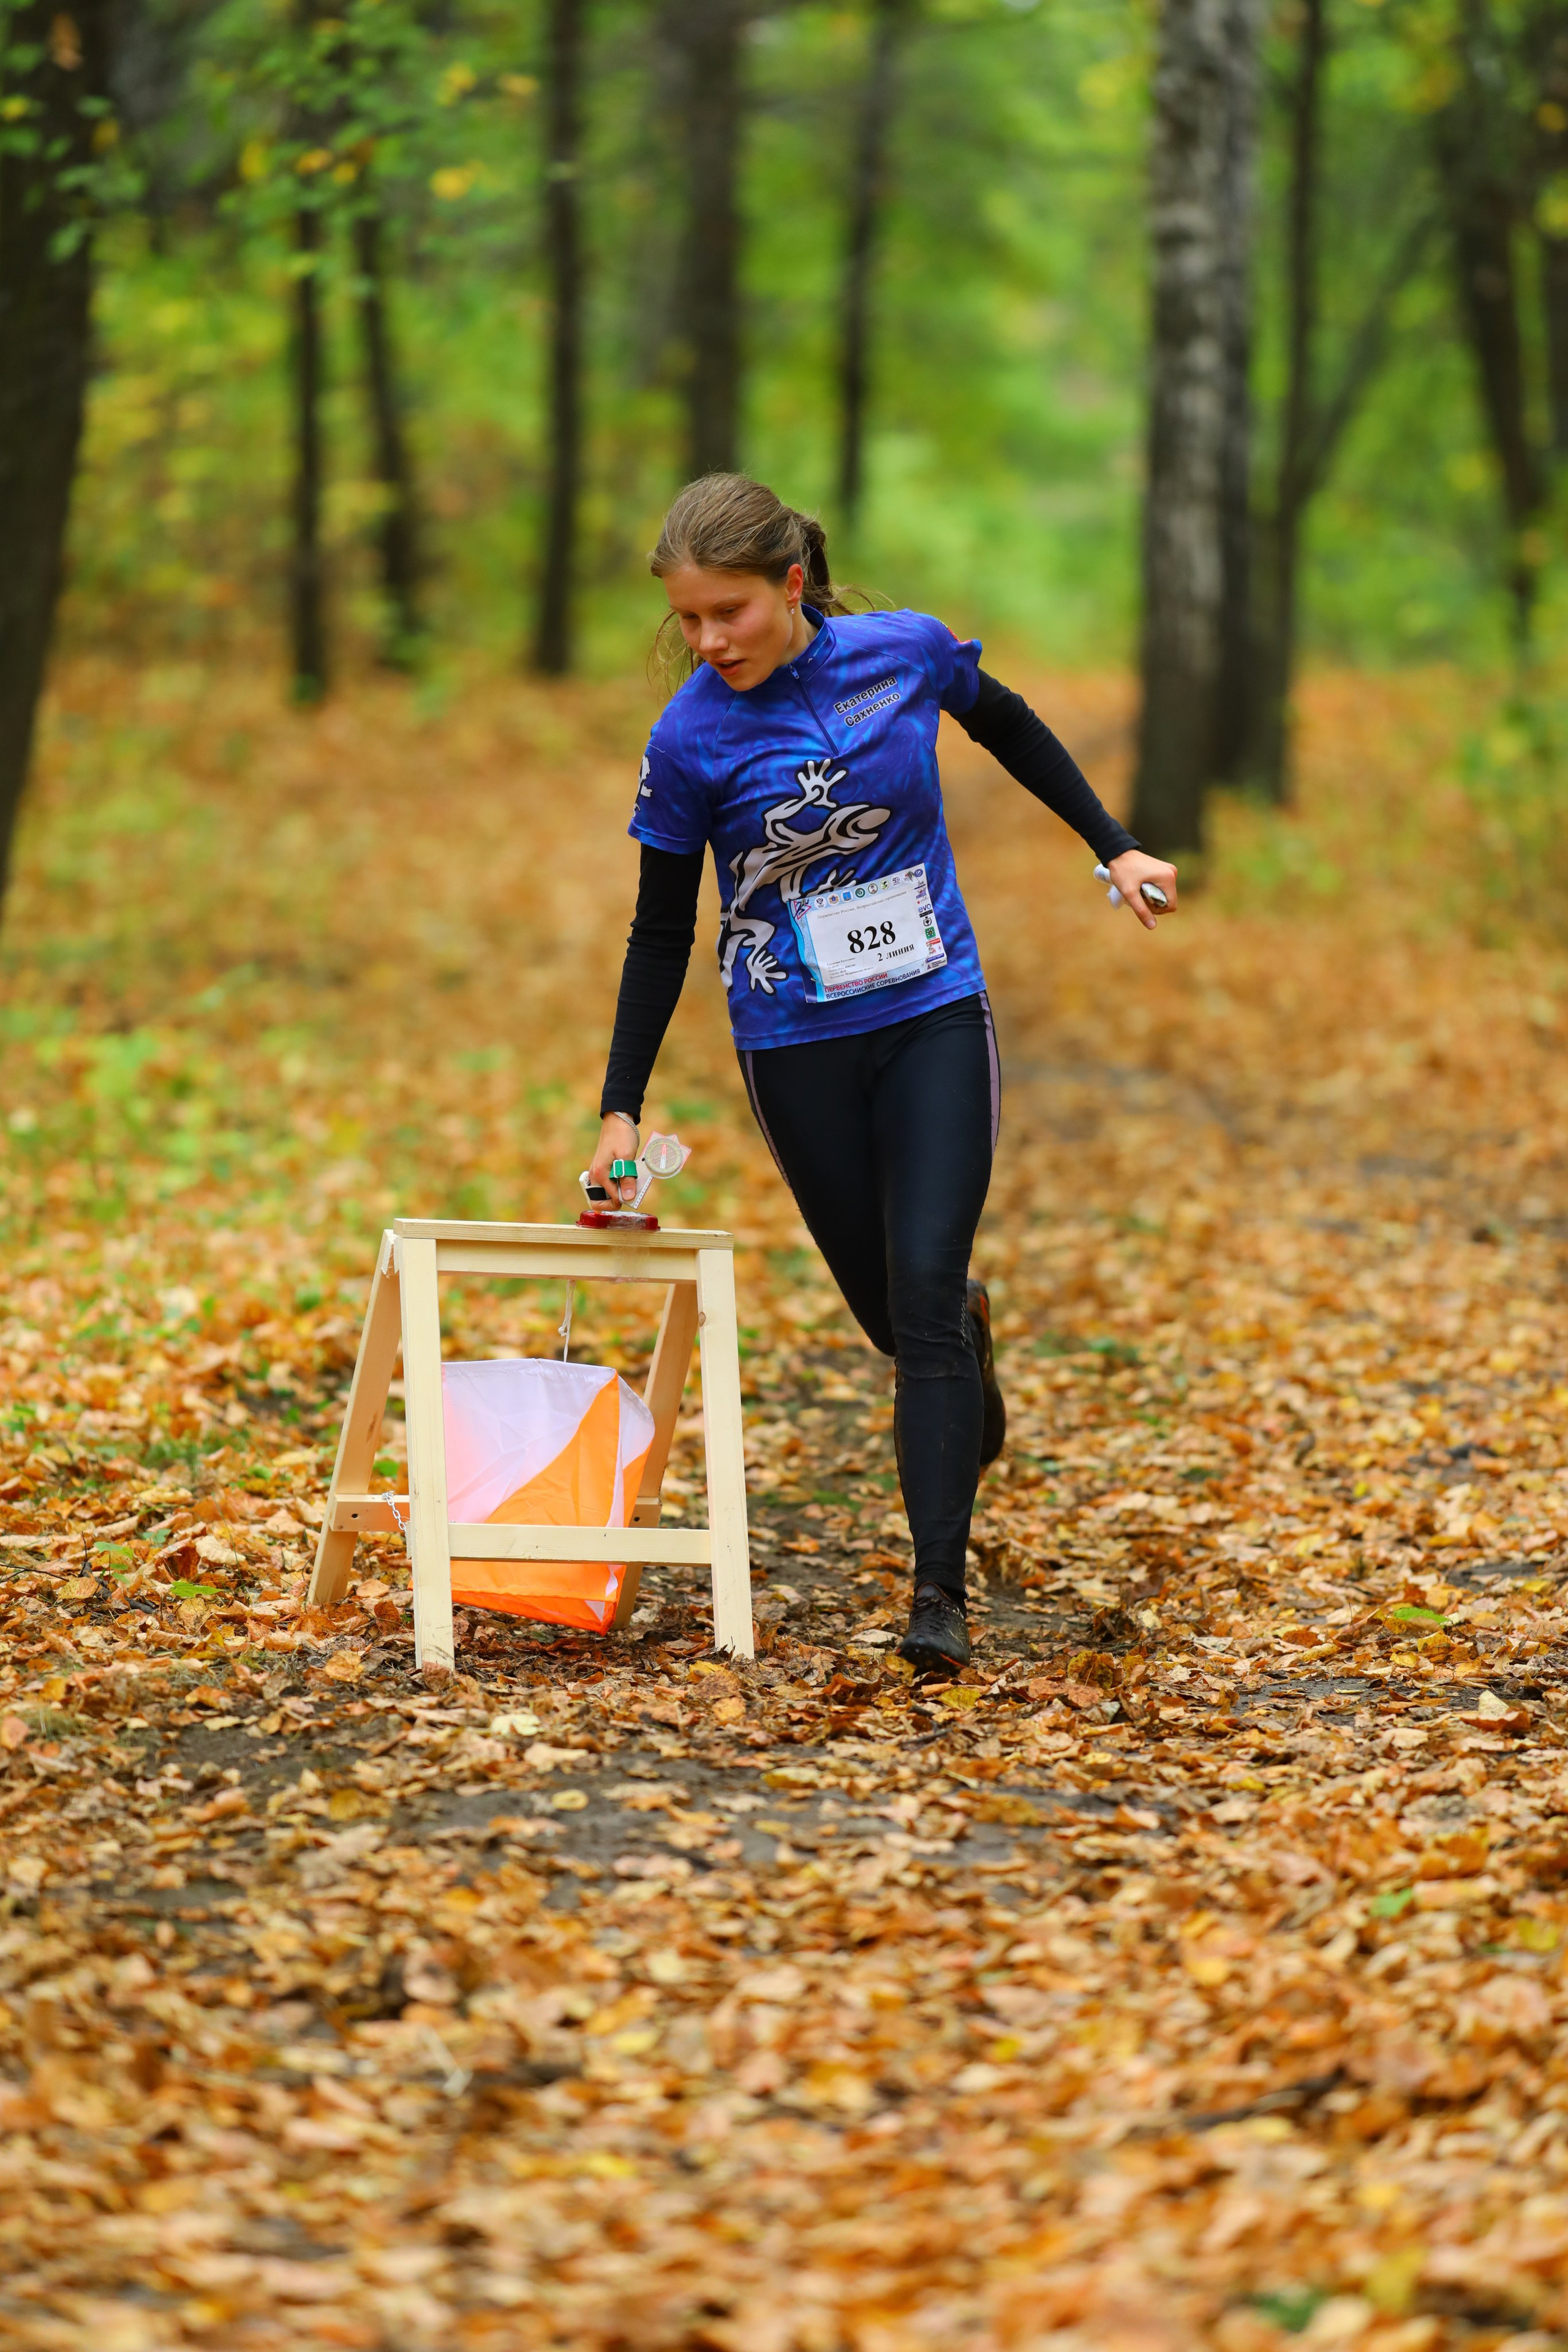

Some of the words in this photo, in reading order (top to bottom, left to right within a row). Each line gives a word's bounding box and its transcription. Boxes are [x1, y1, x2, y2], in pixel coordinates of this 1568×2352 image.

[834, 676, 897, 715] Екатерина
[845, 693, 900, 727] Сахненко
[918, 903, 931, 913] evo
[847, 921, 895, 953] 828
[877, 953, 883, 962] 2
[824, 981, 863, 992] ПЕРВЕНСТВО
[864, 973, 888, 984] РОССИИ
[876, 968, 921, 987] СОРЕВНОВАНИЯ
